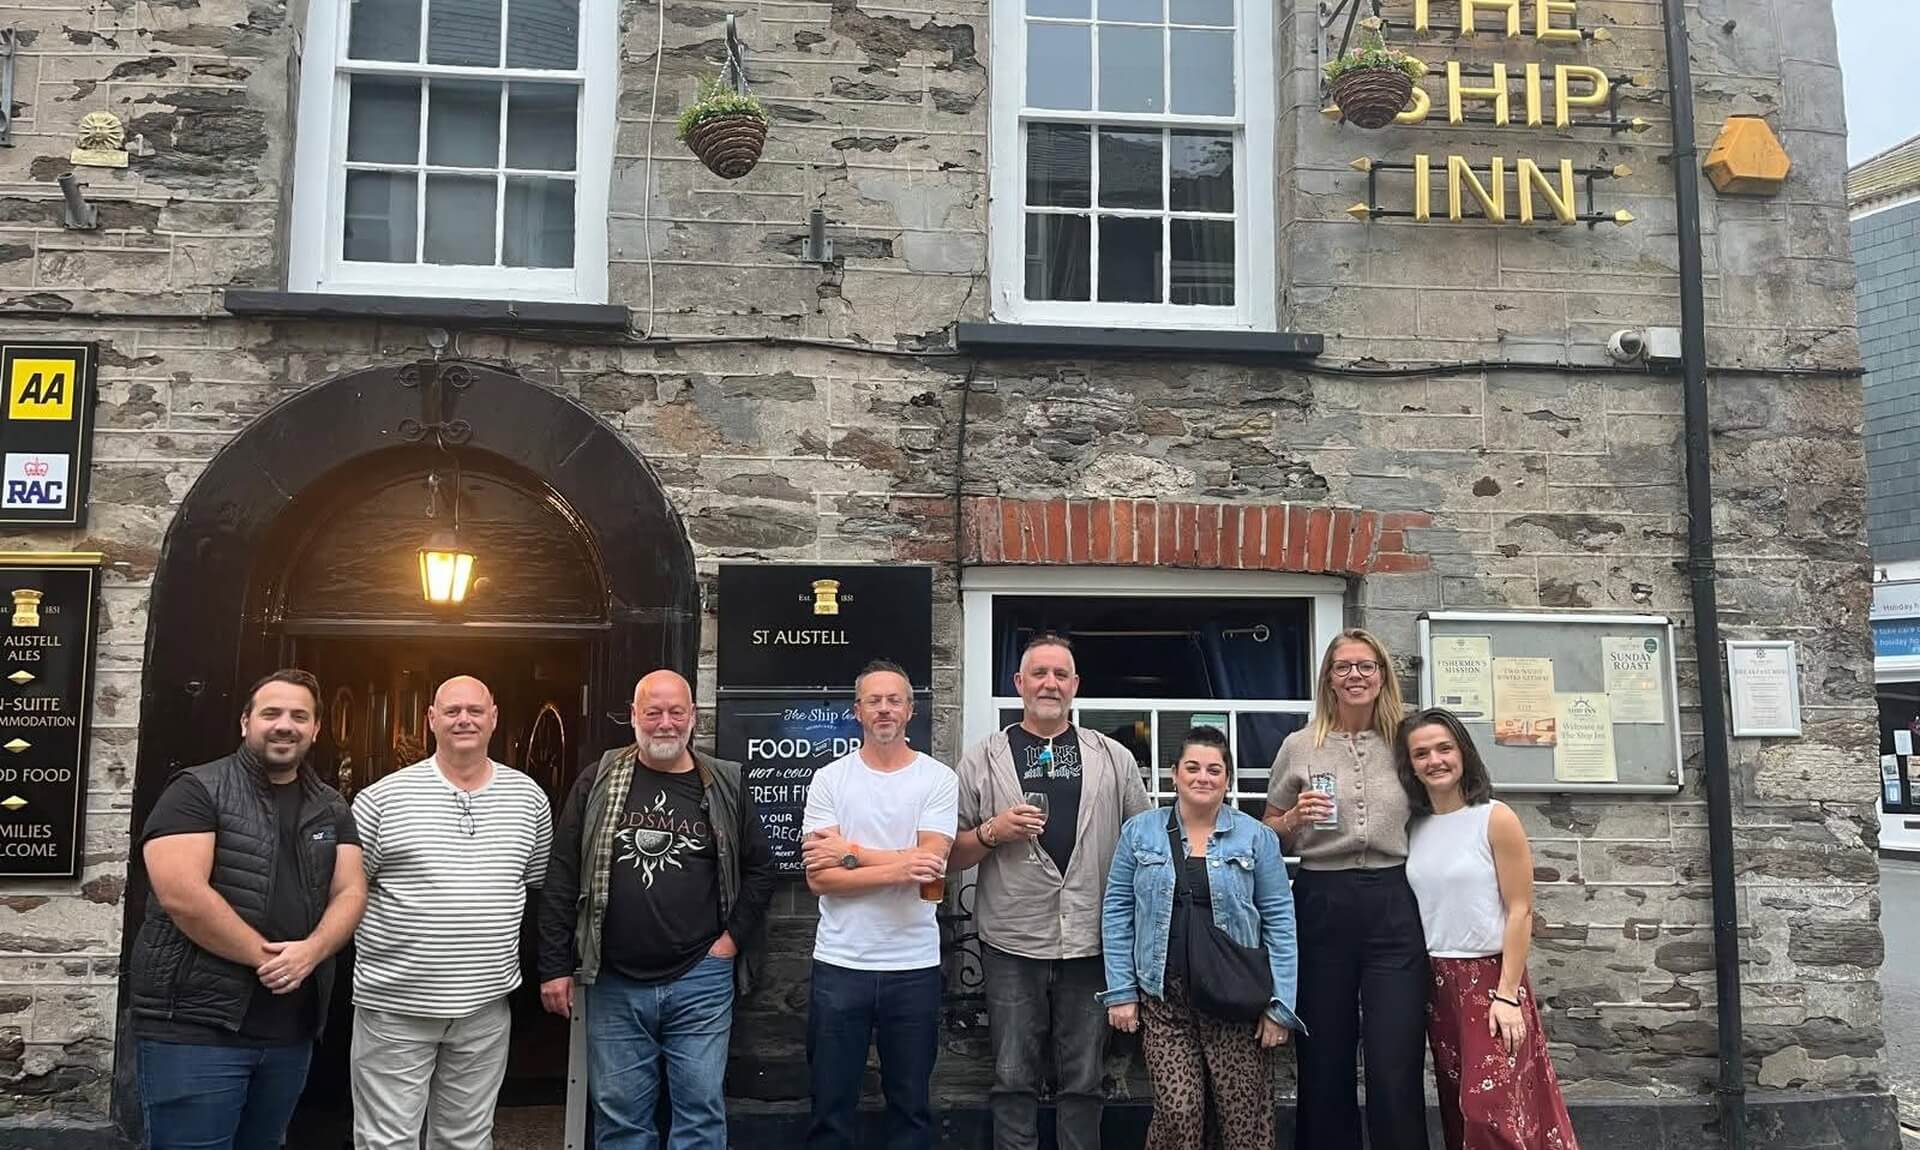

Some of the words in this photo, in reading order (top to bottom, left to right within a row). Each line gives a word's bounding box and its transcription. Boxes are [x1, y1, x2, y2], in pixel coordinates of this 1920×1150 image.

[1415, 154, 1577, 225] INN
[18, 373, 65, 404] AA
[7, 480, 63, 503] RAC
[4, 636, 61, 646] AUSTELL
[752, 631, 769, 644] ST
[774, 631, 849, 644] AUSTELL
[8, 651, 40, 661] ALES
[1610, 652, 1652, 664] SUNDAY
[1614, 661, 1649, 670] ROAST
[784, 708, 806, 720] The
[808, 708, 838, 724] Ship
[748, 739, 811, 760] FOOD
[23, 769, 71, 782] FOOD
[749, 768, 775, 778] HOT
[783, 768, 812, 778] COLD
[760, 813, 793, 823] YOUR
